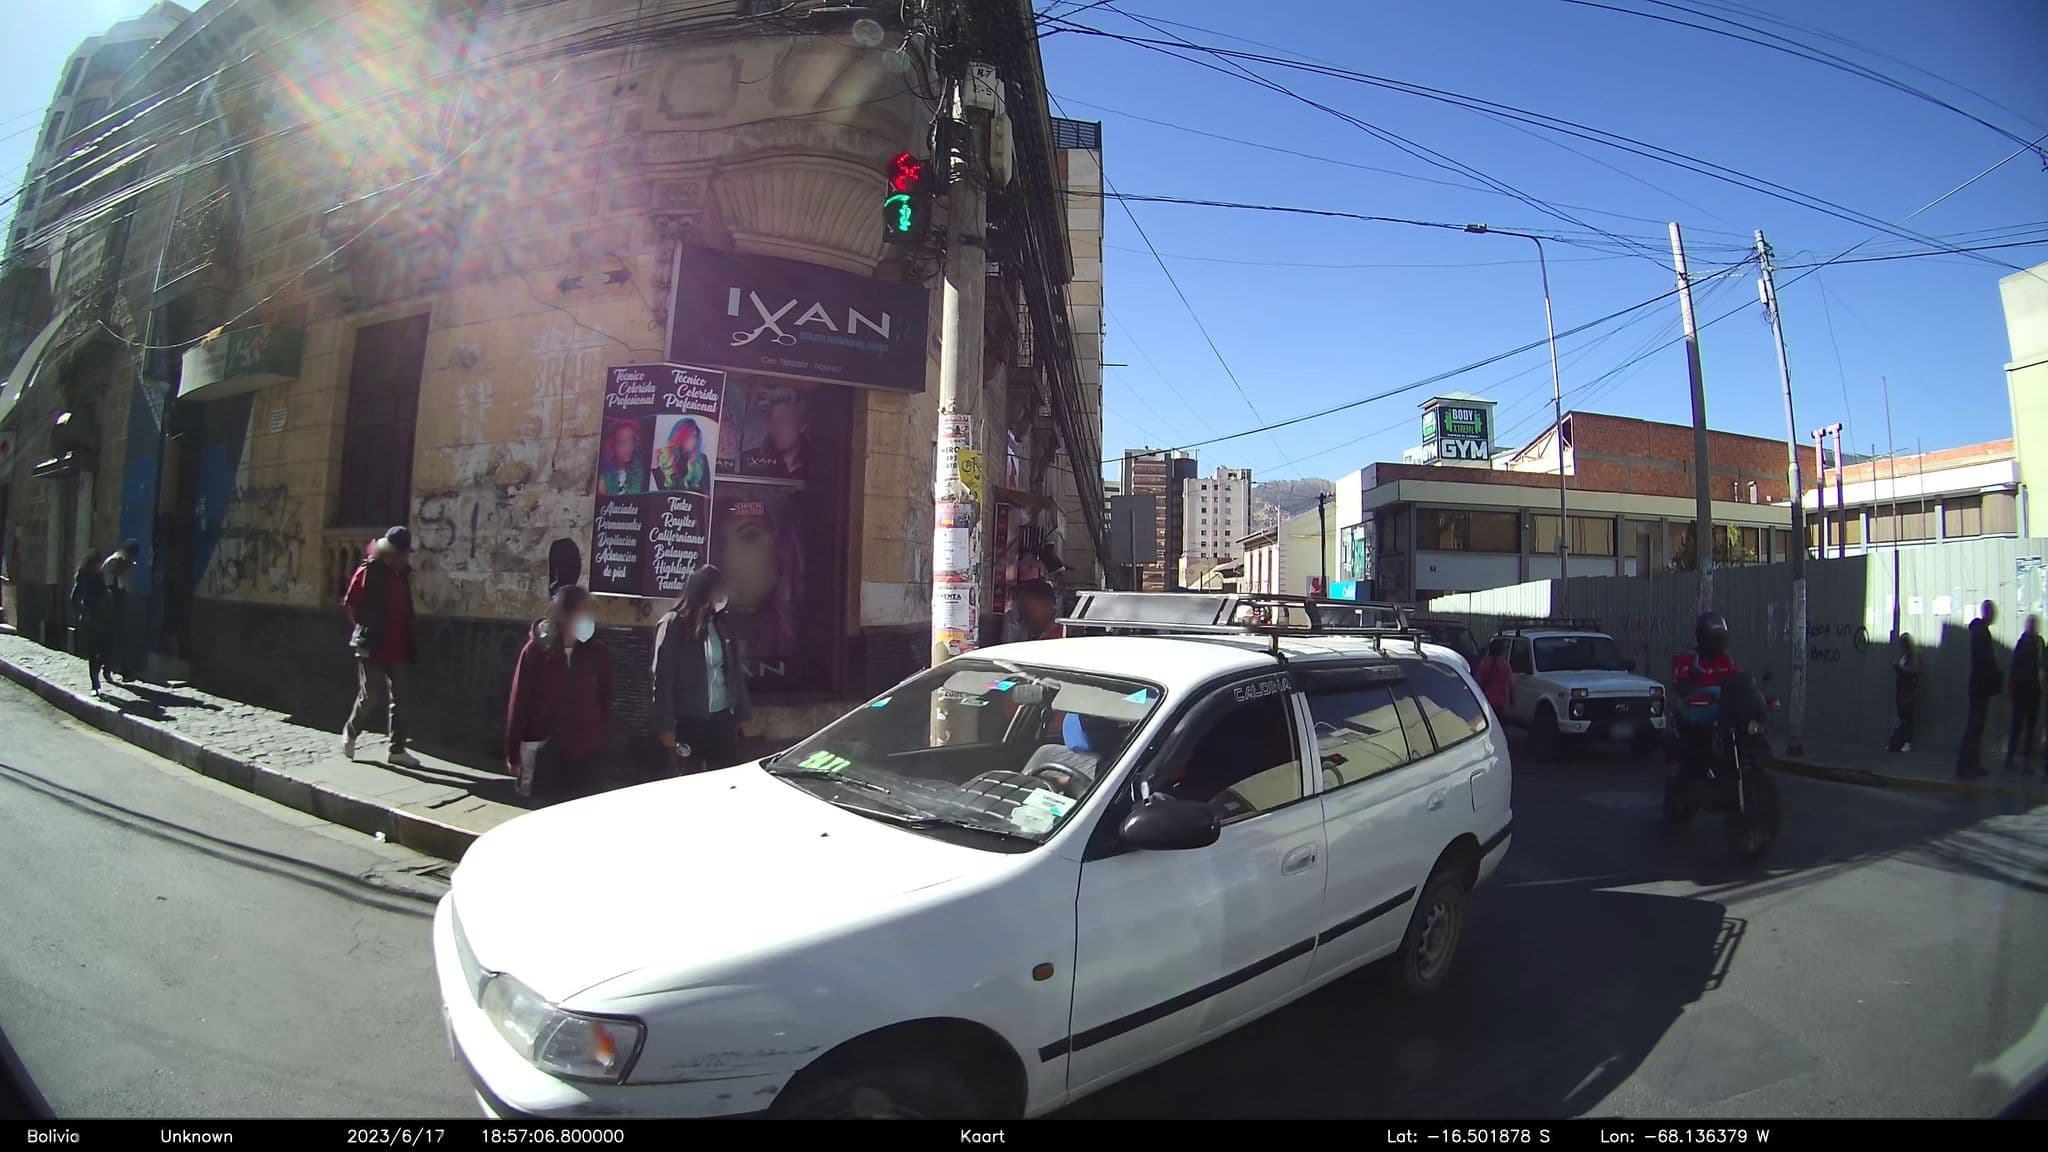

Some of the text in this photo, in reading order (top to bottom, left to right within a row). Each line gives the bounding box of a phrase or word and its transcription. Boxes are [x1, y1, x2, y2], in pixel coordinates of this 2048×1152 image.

[606, 393, 656, 410] Profesional
[663, 393, 718, 413] Profesional
[1452, 408, 1473, 421] BODY
[1441, 439, 1488, 460] GYM
[654, 542, 699, 567] Balayage
[611, 565, 627, 583] piel
